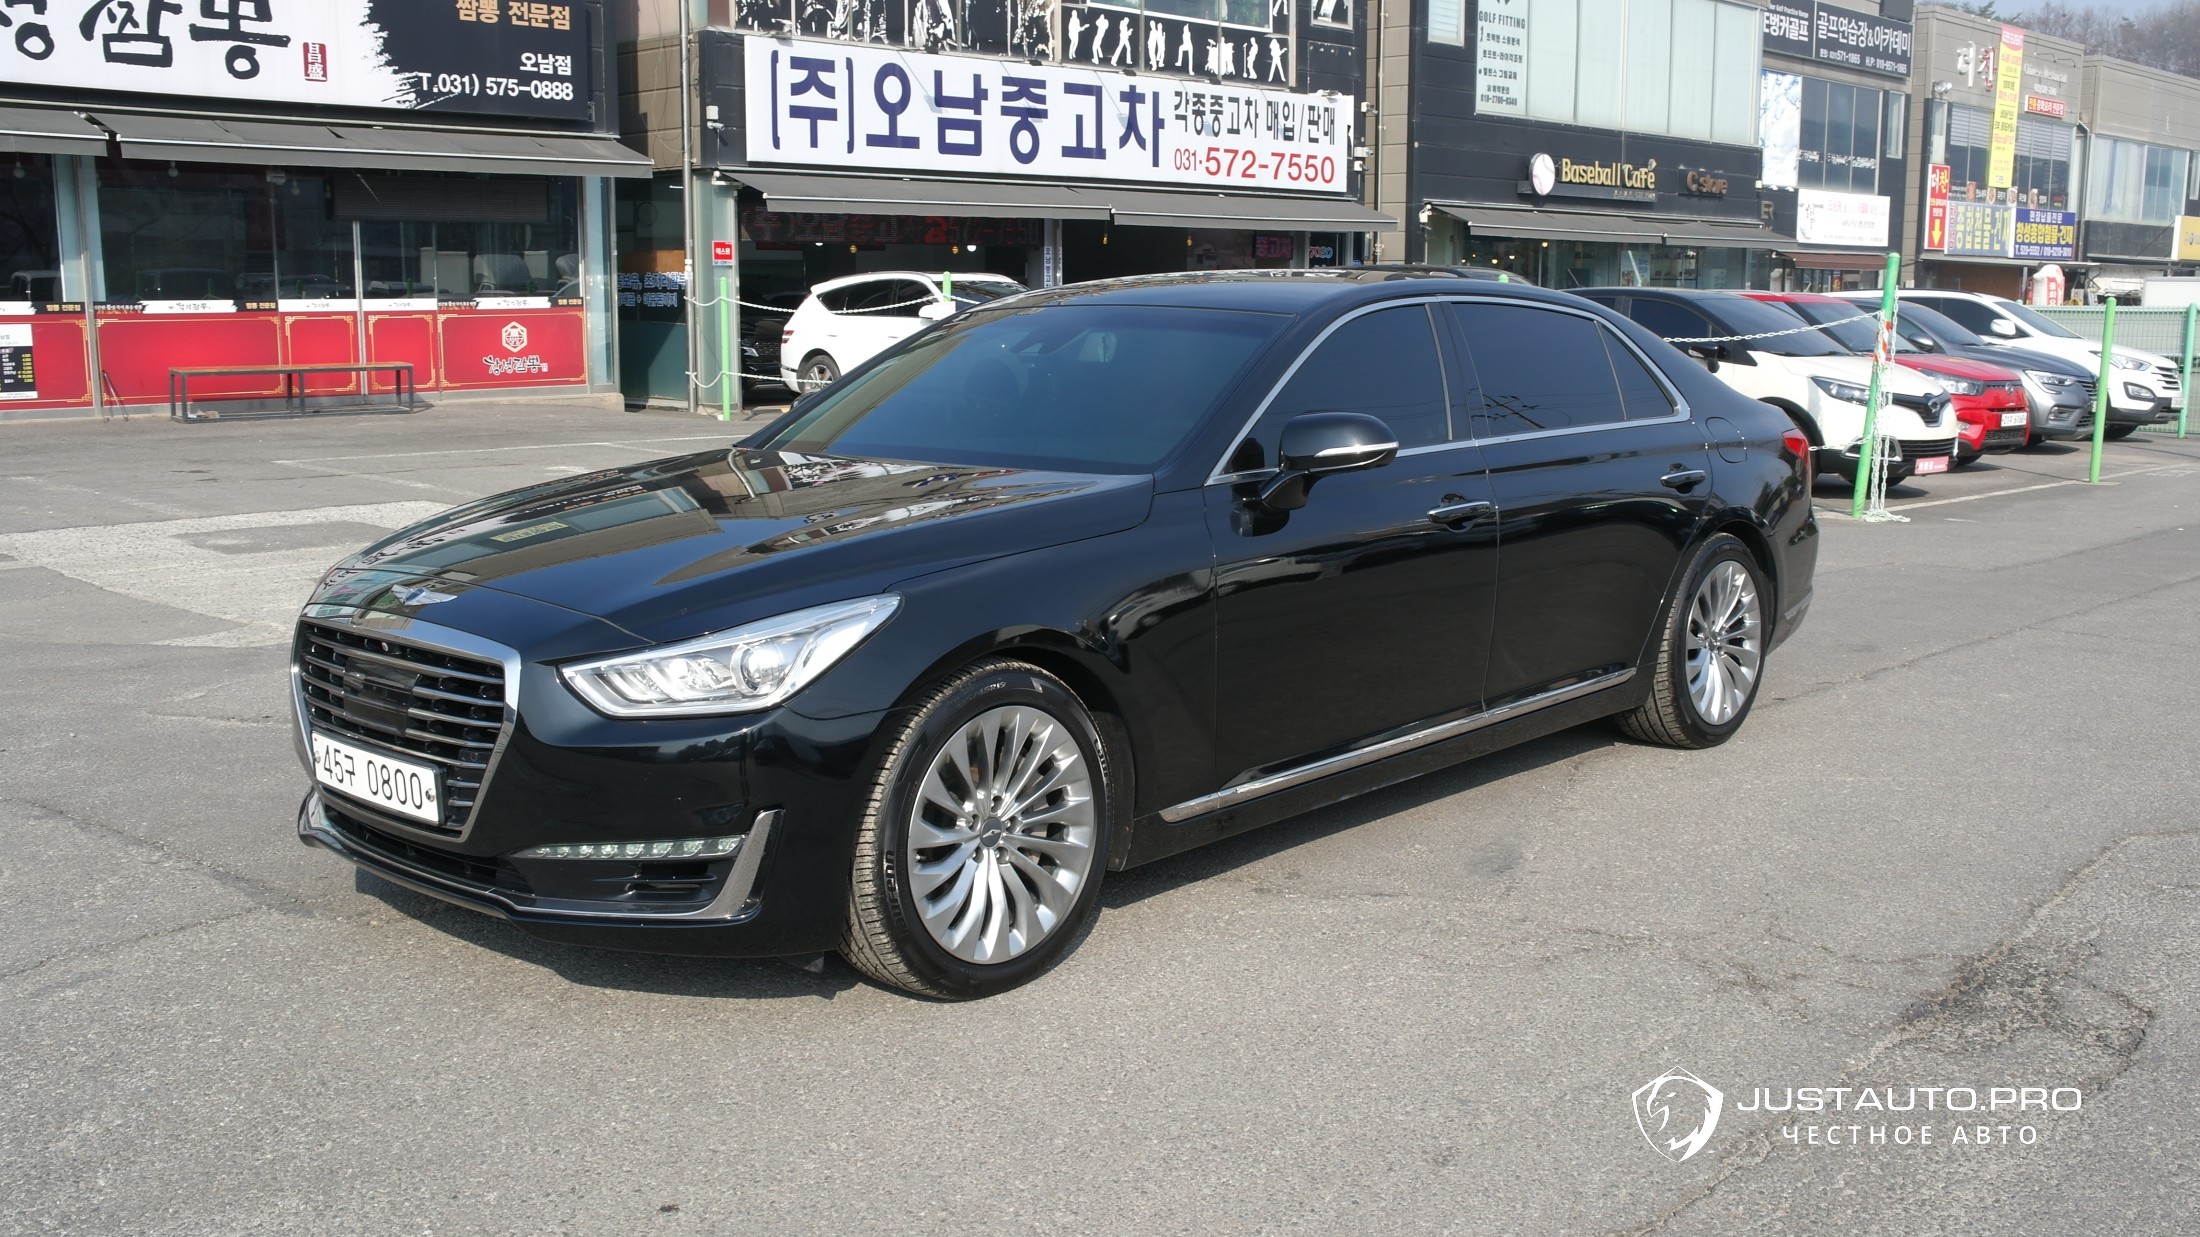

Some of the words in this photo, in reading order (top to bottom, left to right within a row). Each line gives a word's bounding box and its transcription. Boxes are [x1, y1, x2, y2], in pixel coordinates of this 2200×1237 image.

[456, 0, 500, 24] 짬뽕
[507, 1, 571, 30] 전문점
[1478, 10, 1497, 24] GOLF
[1498, 14, 1526, 29] FITTING
[1817, 12, 1911, 57] 골프연습장&아카데미
[519, 52, 572, 76] 오남점
[417, 73, 480, 96] T.031)
[485, 77, 574, 100] 575-0888
[770, 49, 1166, 168] (주)오남중고차
[1173, 90, 1259, 139] 각종중고차
[1265, 100, 1336, 146] 매입/판매
[1561, 158, 1622, 187] Baseball
[323, 744, 356, 787] 45구
[366, 759, 423, 810] 0800
